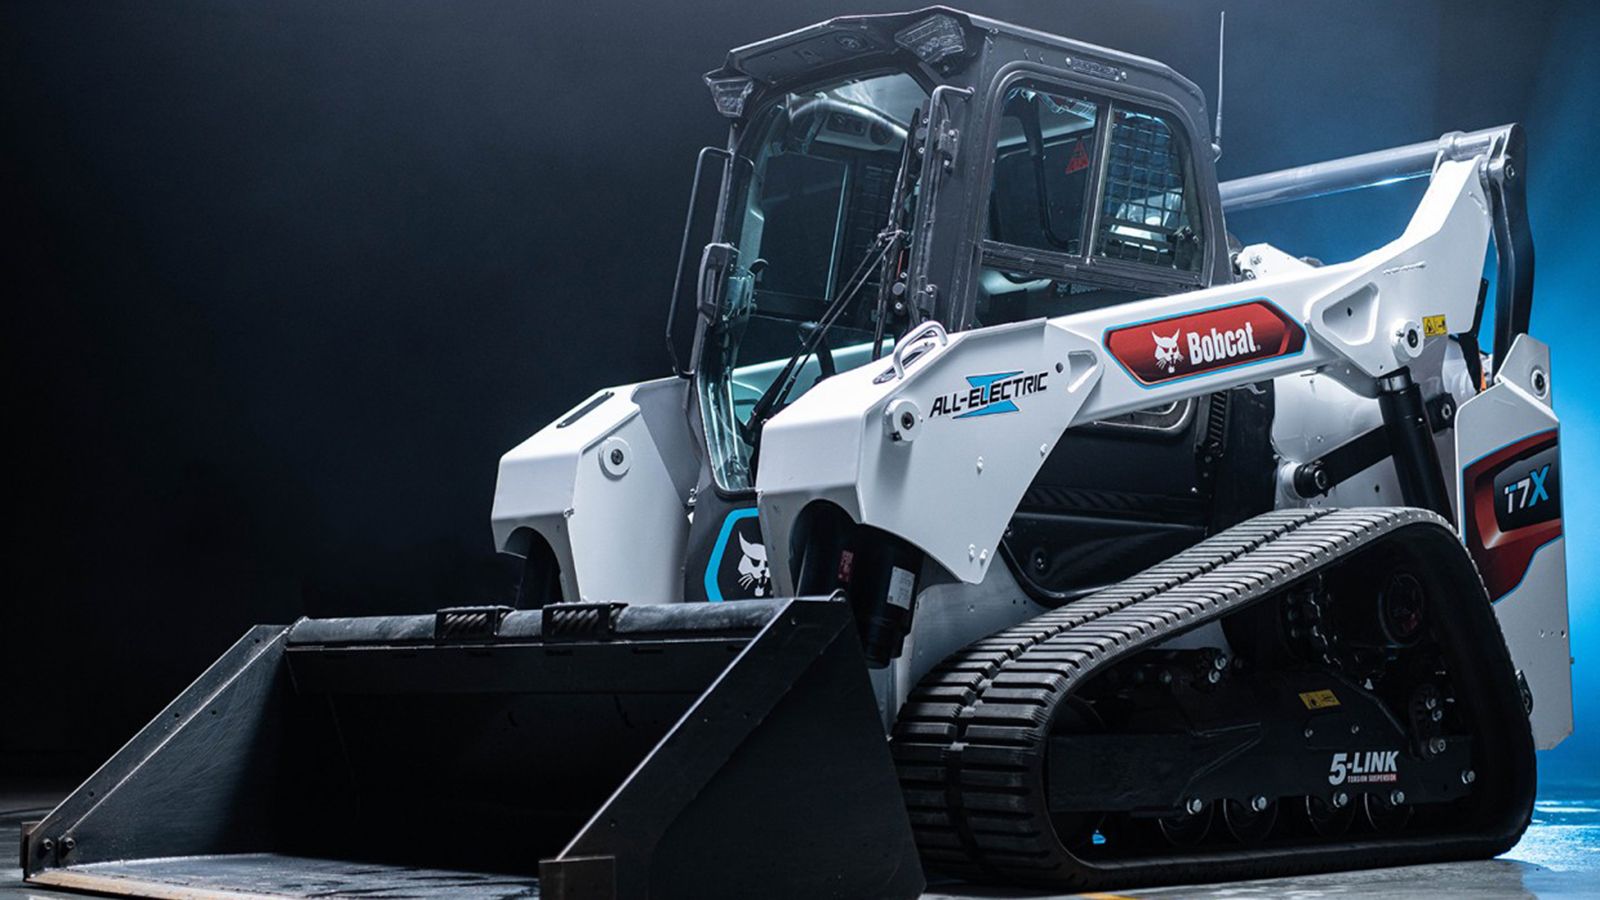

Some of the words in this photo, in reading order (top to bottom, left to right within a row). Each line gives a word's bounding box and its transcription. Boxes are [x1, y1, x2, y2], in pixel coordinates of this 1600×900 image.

[1186, 322, 1256, 365] Bobcat
[929, 372, 1049, 418] ALL-ELECTRIC
[1504, 464, 1551, 514] T7X
[1328, 751, 1399, 786] 5-LINK
